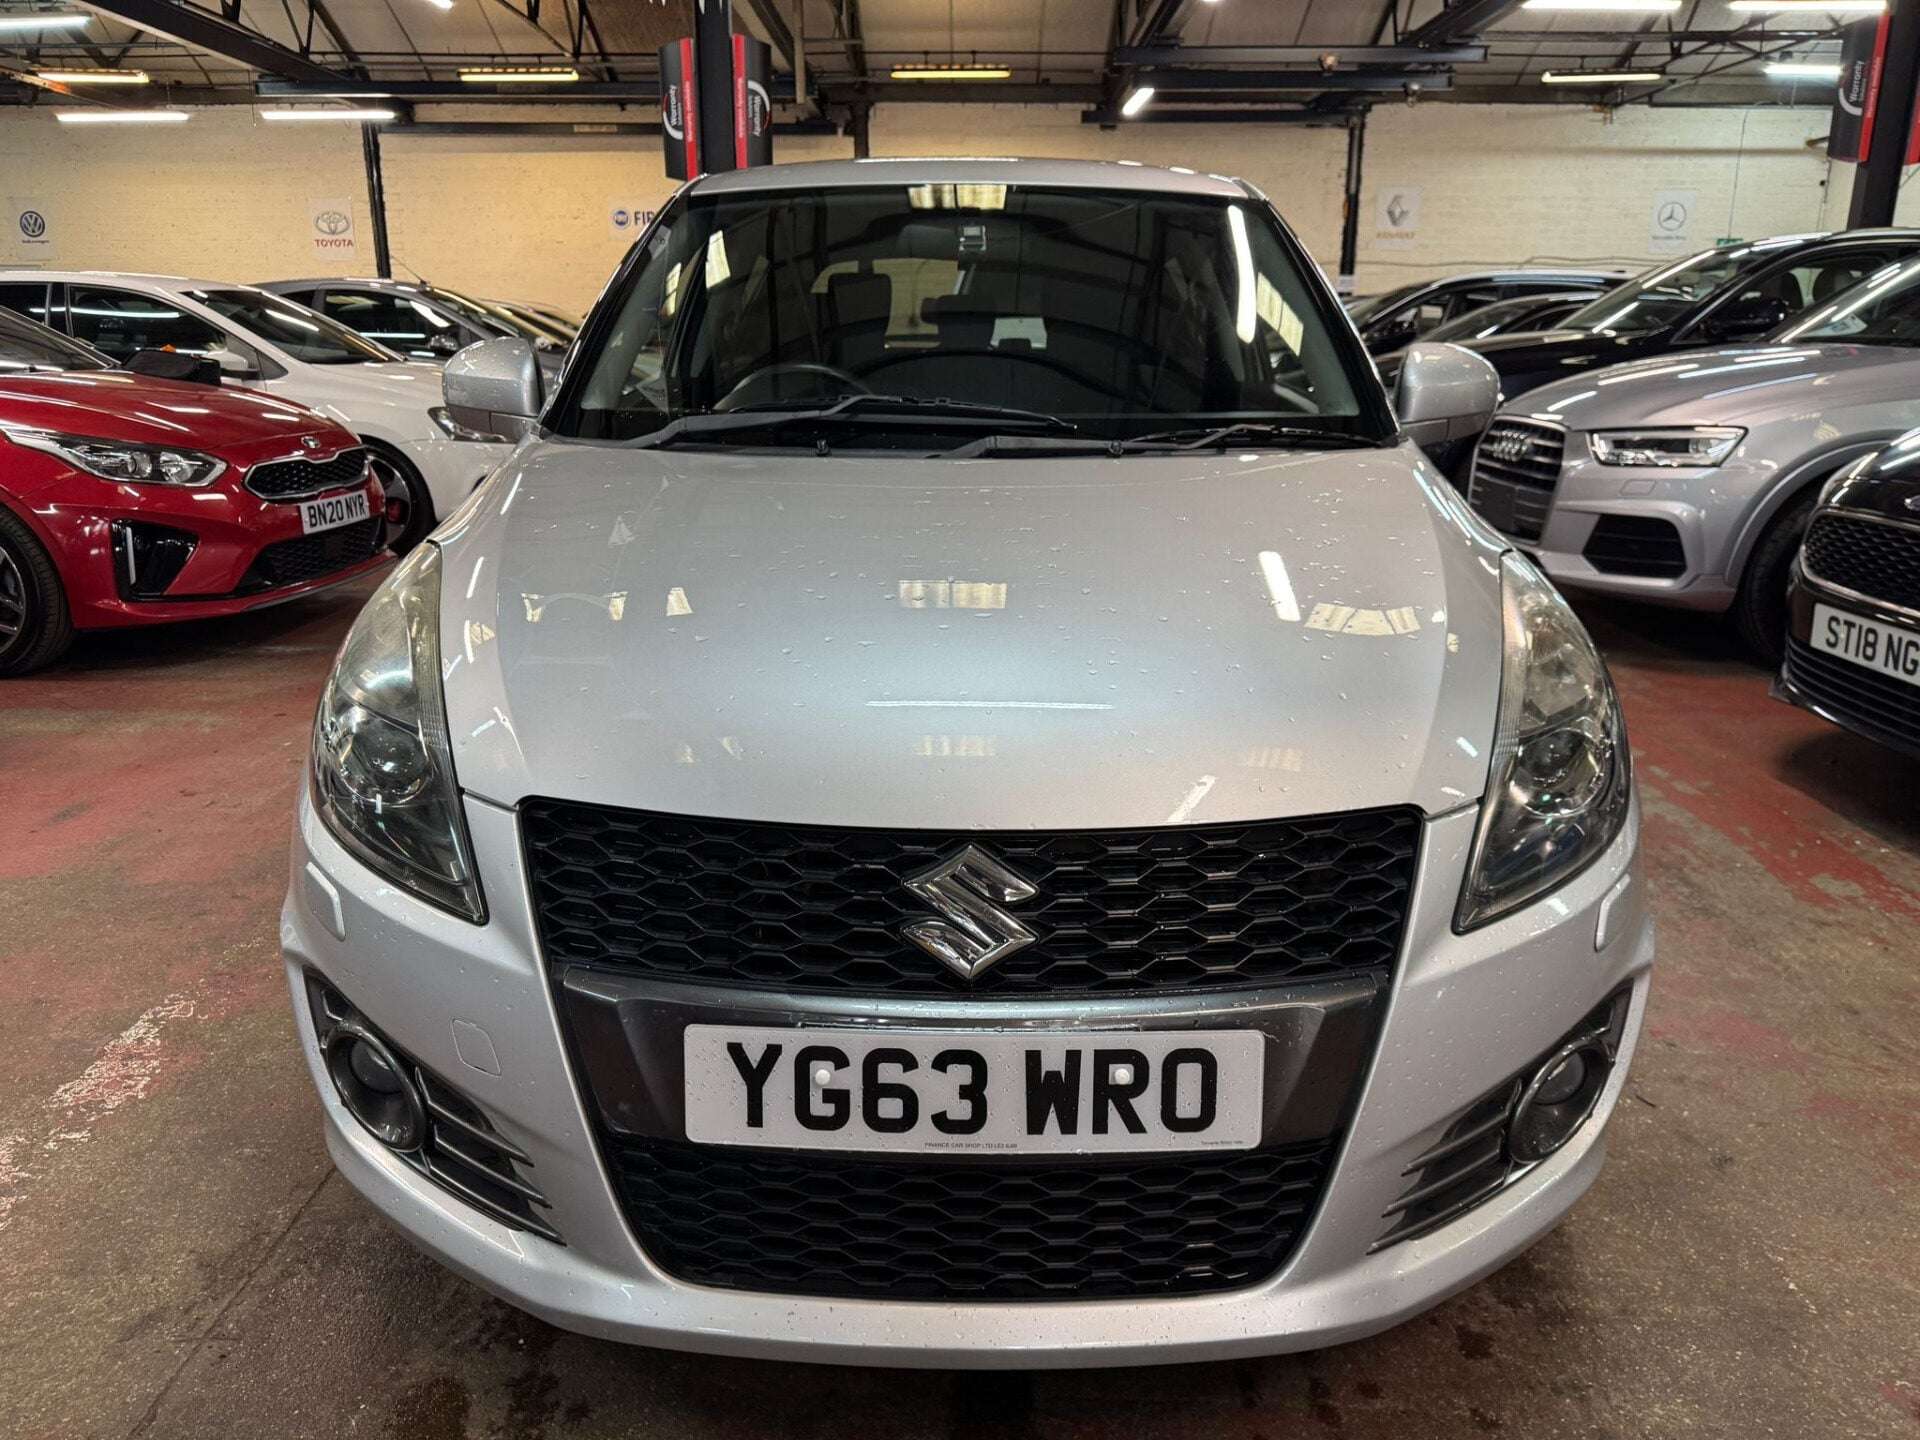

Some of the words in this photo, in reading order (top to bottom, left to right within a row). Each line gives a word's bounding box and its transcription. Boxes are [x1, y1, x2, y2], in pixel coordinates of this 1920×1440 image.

[1850, 60, 1865, 102] Warranty
[669, 84, 678, 126] Warranty
[753, 95, 762, 137] Warranty
[315, 239, 354, 248] TOYOTA
[307, 500, 344, 528] BN20
[345, 494, 366, 519] NYR
[1825, 615, 1879, 662] ST18
[1883, 632, 1920, 676] NG
[726, 1041, 988, 1135] YG63
[1025, 1047, 1218, 1136] WRO
